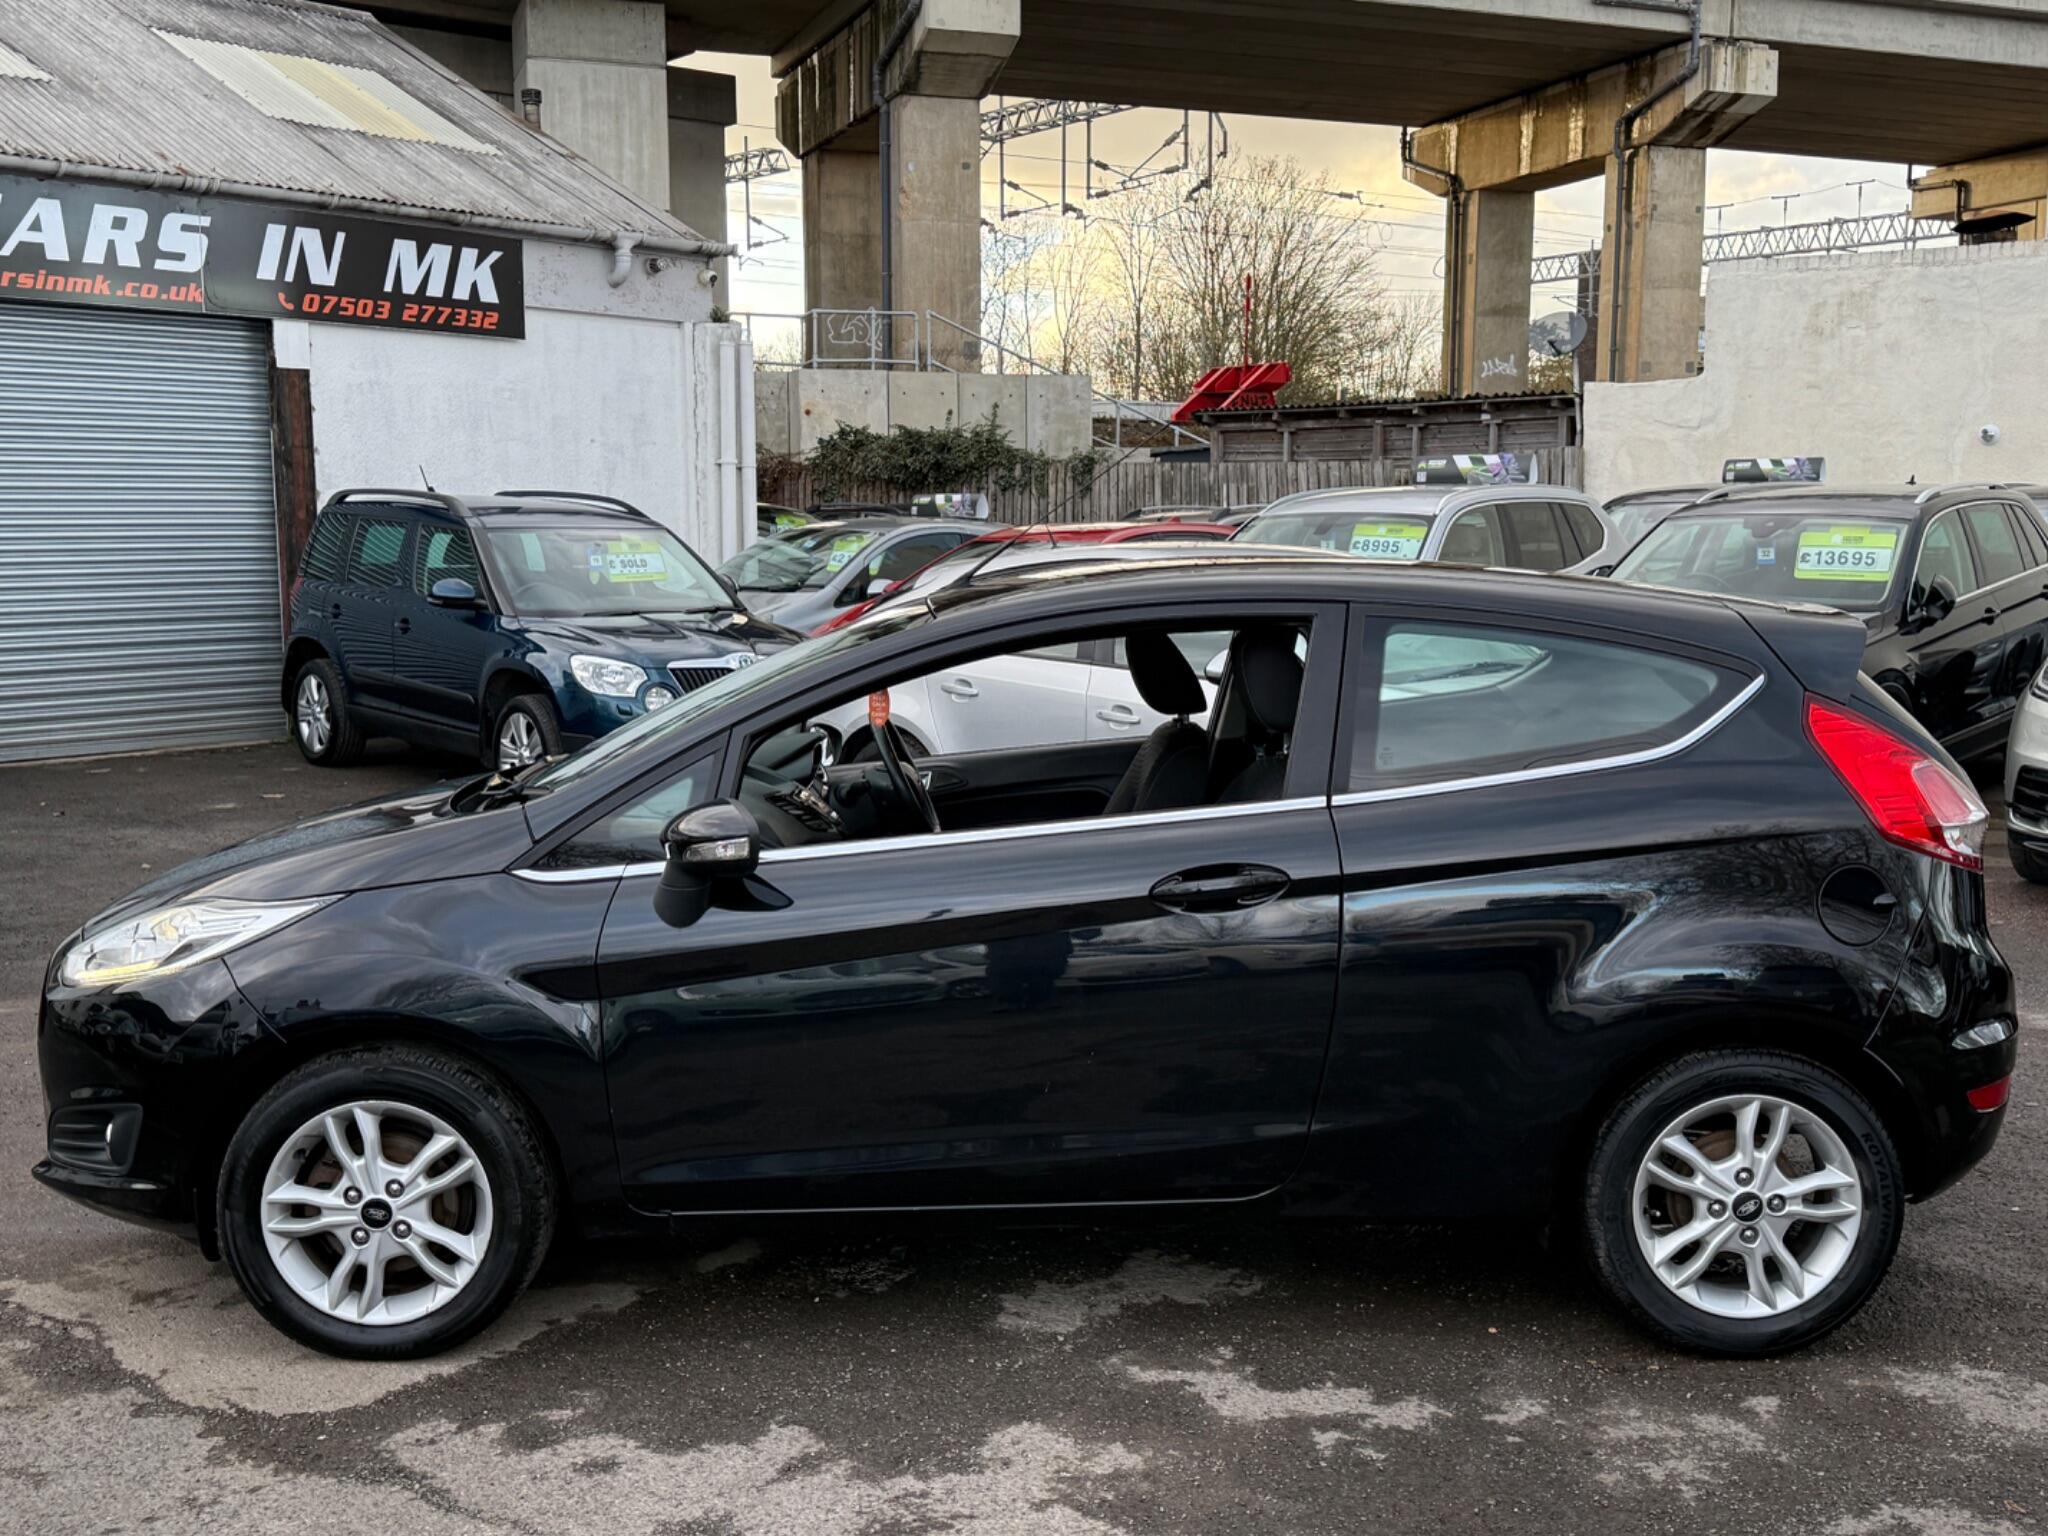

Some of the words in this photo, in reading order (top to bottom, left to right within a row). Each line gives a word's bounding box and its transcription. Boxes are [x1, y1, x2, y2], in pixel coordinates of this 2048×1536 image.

[0, 195, 212, 273] ARS
[256, 223, 346, 287] IN
[383, 238, 504, 304] MK
[302, 293, 391, 320] 07503
[402, 303, 500, 330] 277332
[1352, 539, 1401, 553] £8995
[620, 559, 648, 569] SOLD
[1800, 550, 1877, 567] £13695
